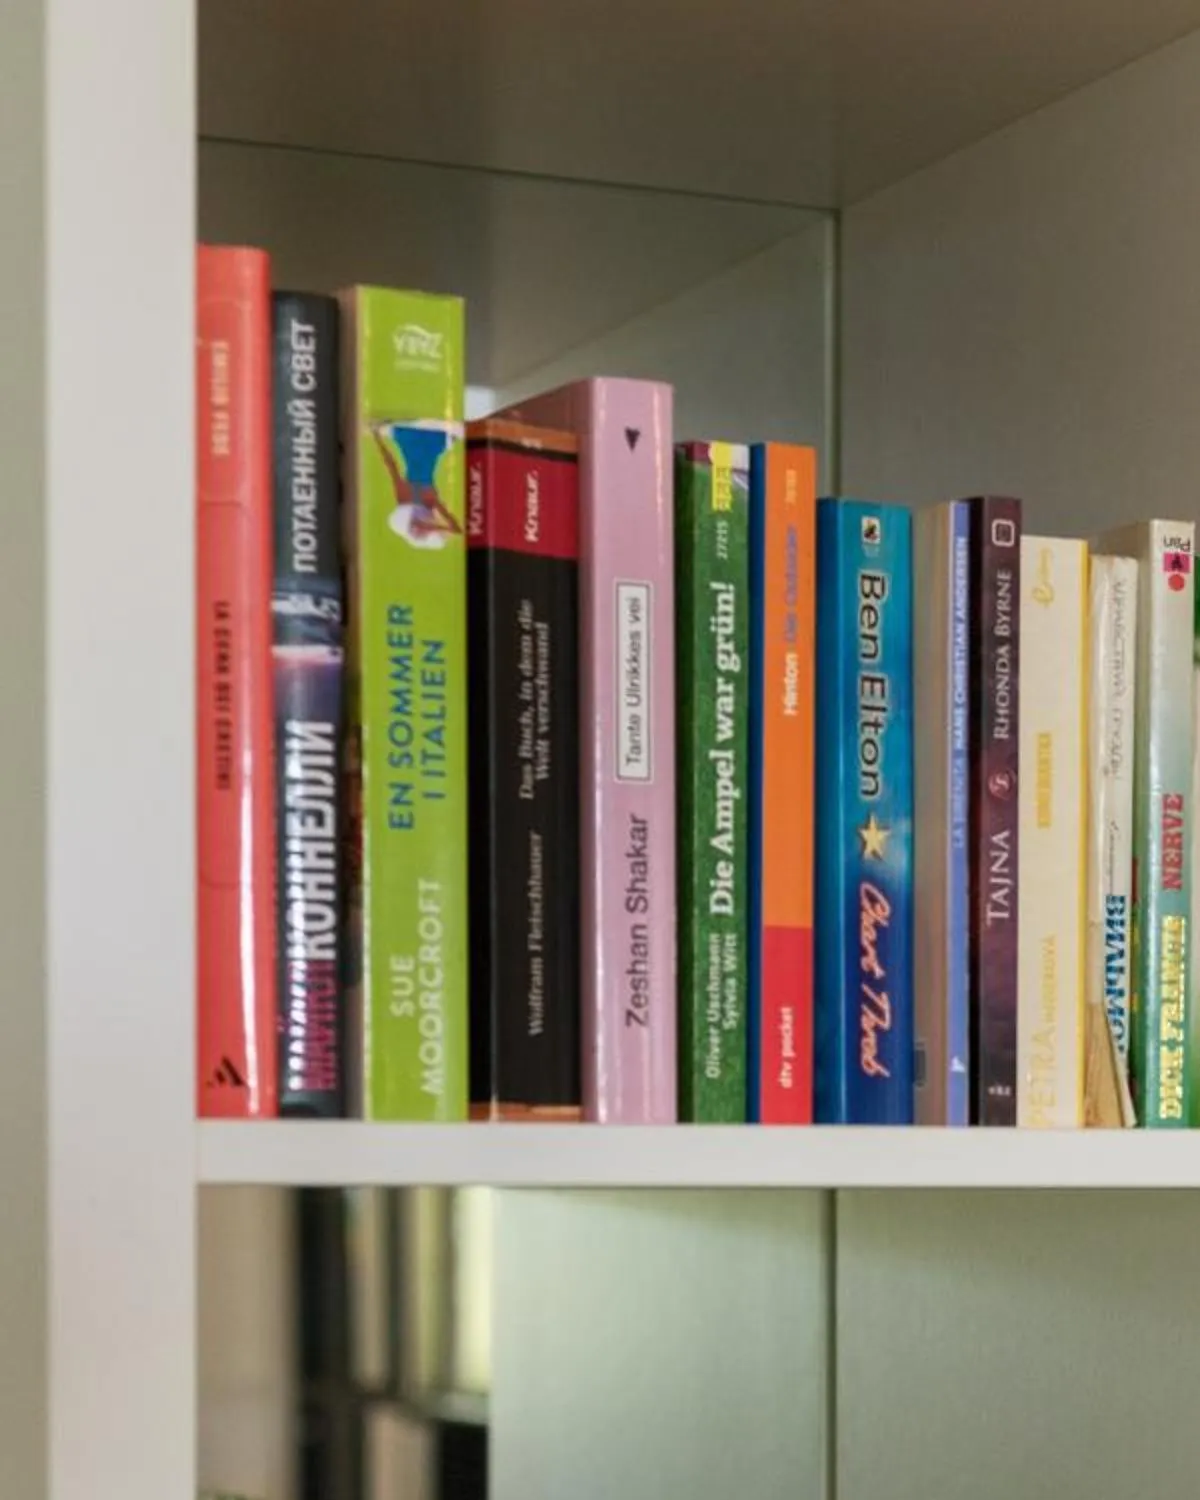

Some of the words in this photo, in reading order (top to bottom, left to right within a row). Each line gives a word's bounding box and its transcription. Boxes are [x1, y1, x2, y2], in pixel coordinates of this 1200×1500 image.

[291, 319, 316, 391] СВЕТ
[287, 400, 317, 573] ПОТАЕННЫЙ
[625, 596, 643, 624] vei
[858, 570, 889, 660] Ben
[954, 537, 967, 619] ANDERSEN
[993, 569, 1012, 636] BYRNE
[709, 581, 742, 673] grün!
[954, 623, 966, 704] CHRISTIAN
[386, 604, 414, 768] SOMMER
[517, 681, 532, 700] in
[624, 628, 643, 707] Ulrikkes
[783, 652, 800, 716] Hinton
[993, 642, 1009, 740] RHONDA
[421, 640, 447, 779] ITALIEN
[624, 711, 643, 766] Tante
[714, 678, 735, 741] war
[857, 674, 889, 798] Elton
[954, 706, 966, 750] HANS
[387, 782, 415, 830] EN
[519, 762, 534, 799] Das
[708, 750, 740, 854] Ampel
[286, 719, 337, 960] КОННЕЛЛИ
[625, 811, 651, 914] Shakar
[986, 829, 1010, 927] TAJNA
[1162, 794, 1184, 890] NERVE
[526, 831, 544, 951] Fleischhauer
[709, 860, 735, 915] Die
[721, 932, 737, 972] Witt
[859, 882, 892, 980] Chart
[390, 955, 415, 1017] SUE
[418, 877, 444, 1095] MOORCROFT
[526, 957, 545, 1035] Wolfram
[626, 923, 651, 1028] Zeshan
[705, 932, 722, 1022] Uschmann
[721, 978, 741, 1030] Sylvia
[1159, 915, 1186, 1042] FRANCIS
[705, 1027, 722, 1078] Oliver
[778, 1007, 795, 1058] pocket
[778, 1062, 793, 1088] dtv
[1159, 1045, 1185, 1120] DICK
